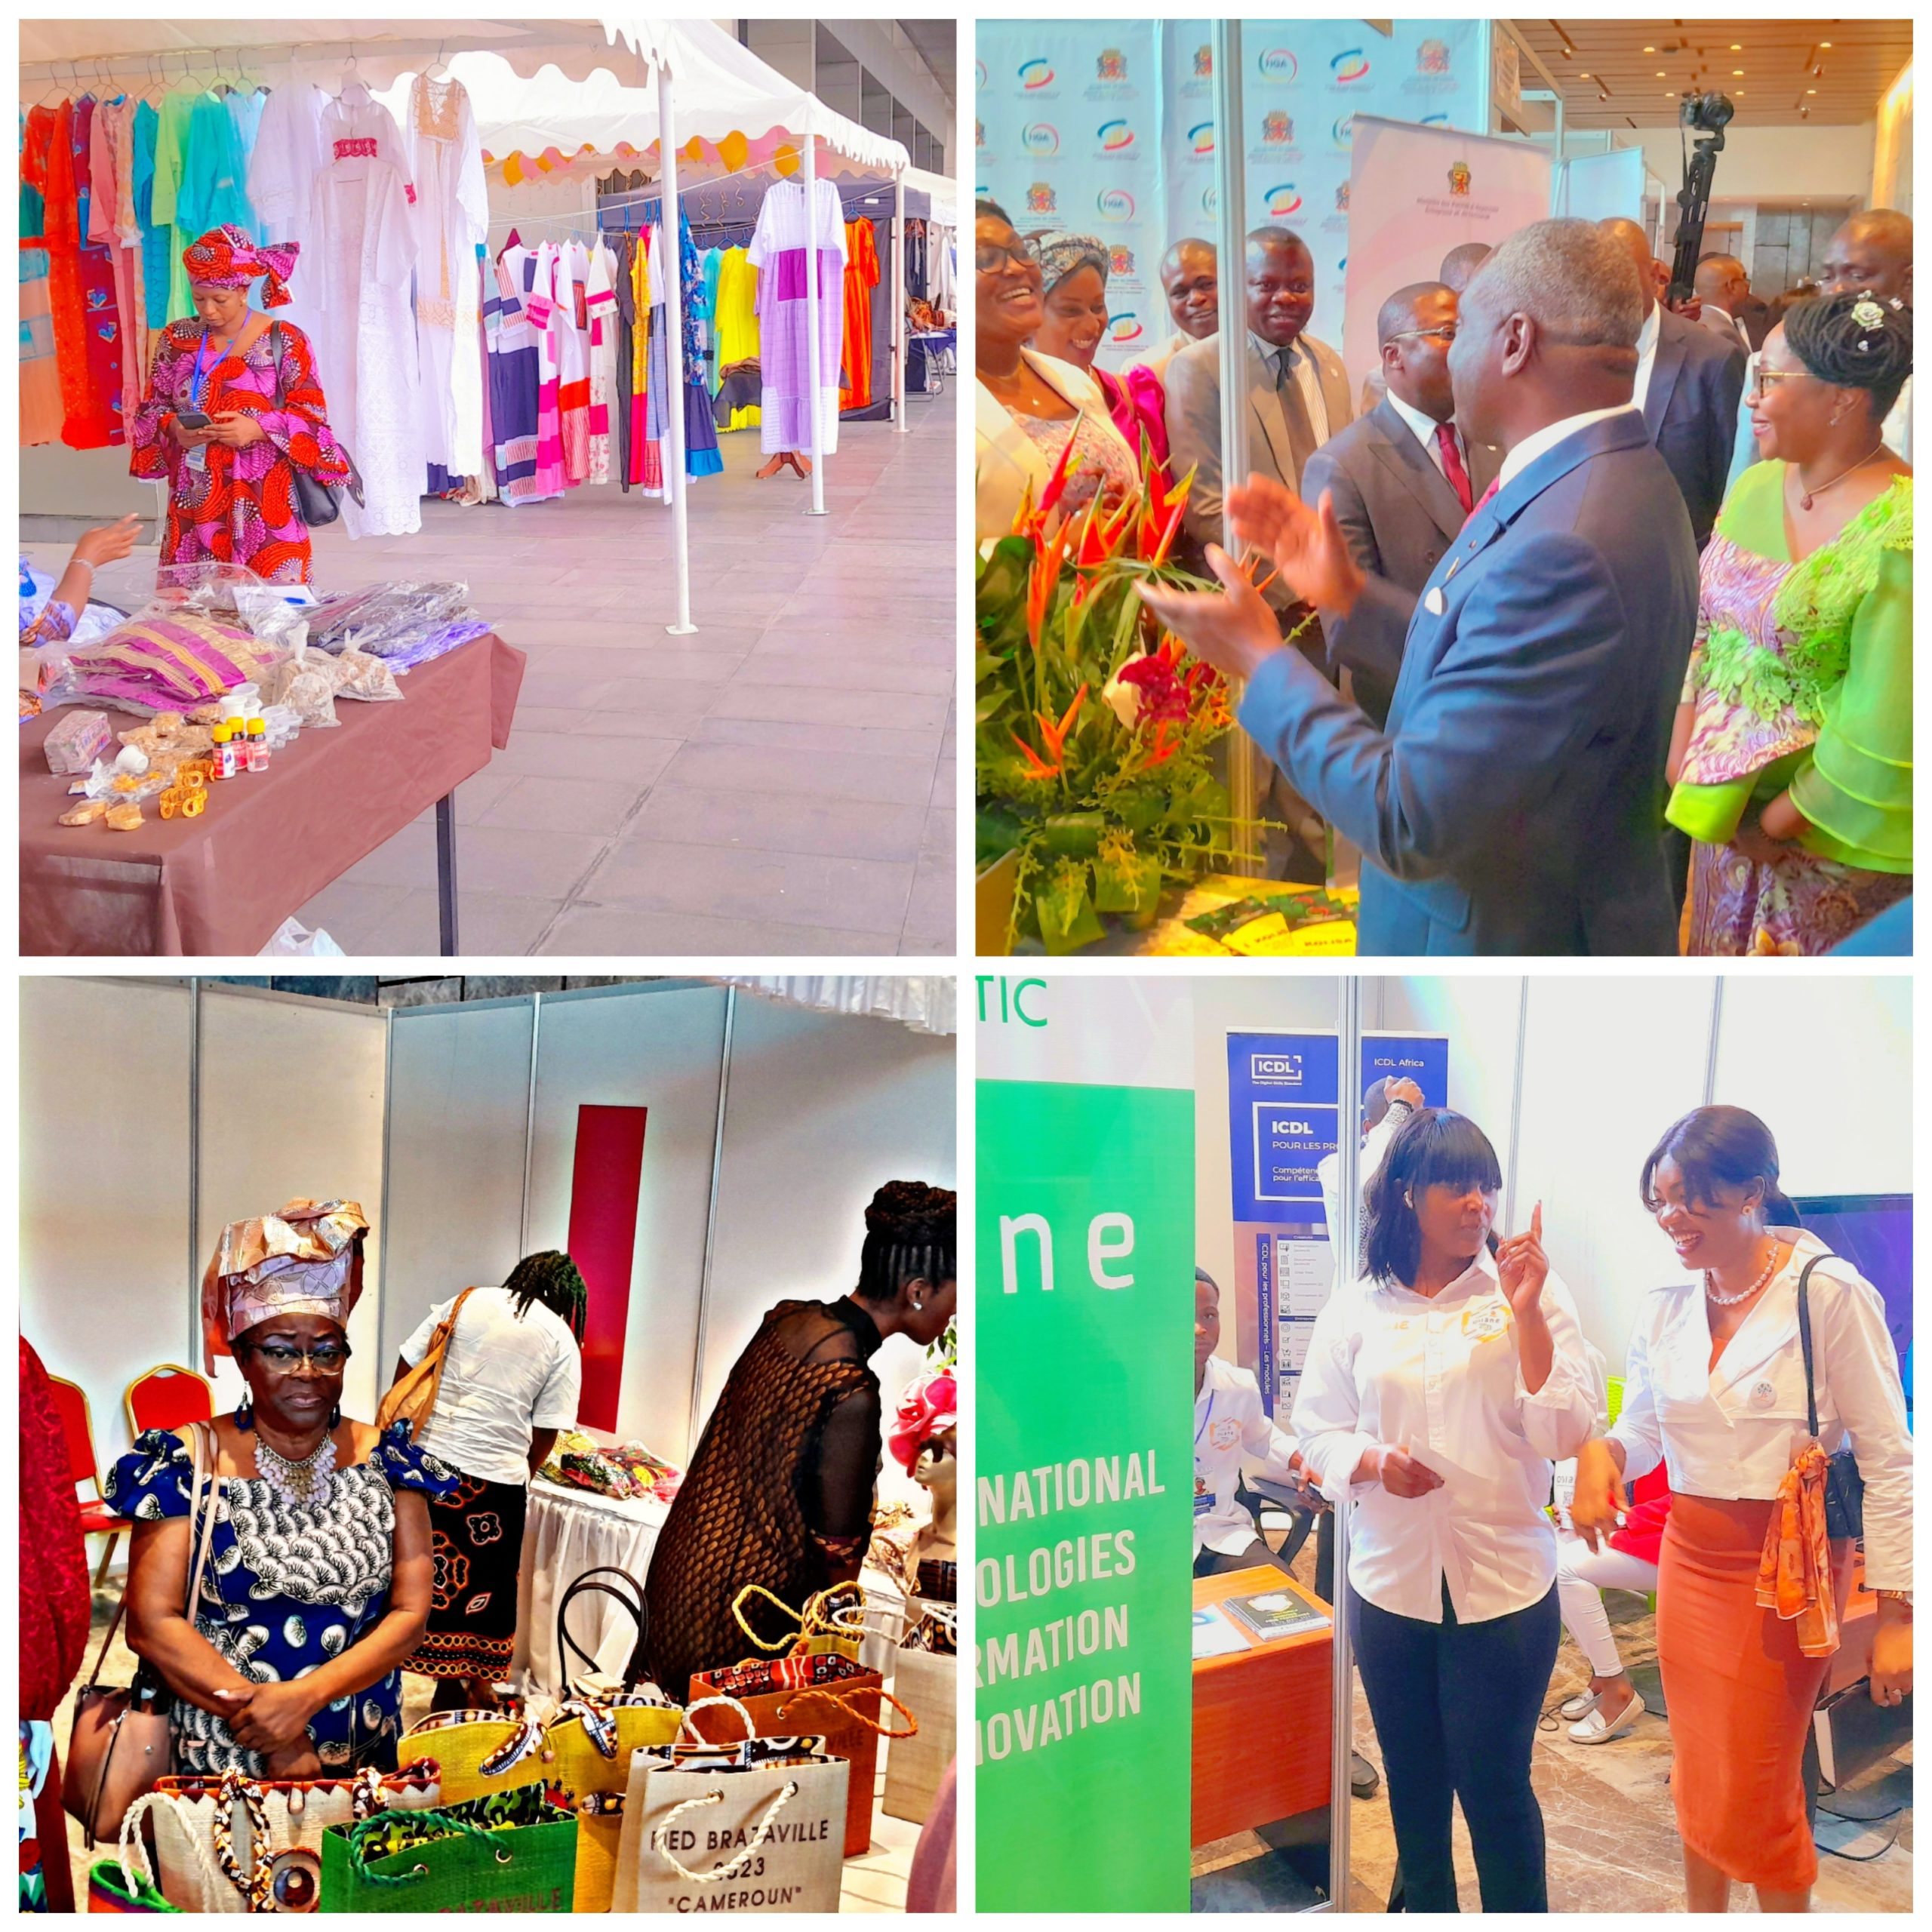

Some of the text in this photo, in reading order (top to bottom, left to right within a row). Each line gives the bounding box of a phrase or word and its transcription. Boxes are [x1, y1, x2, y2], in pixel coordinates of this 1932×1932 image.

[975, 976, 1048, 1027] TIC
[1258, 1060, 1294, 1073] ICDL
[1374, 1058, 1425, 1067] ICDL Africa
[1272, 1121, 1313, 1134] ICDL
[1272, 1141, 1301, 1149] POUR
[1303, 1142, 1321, 1150] LES
[1262, 1293, 1271, 1344] professionnels
[977, 1449, 1166, 1527] NATIONAL
[976, 1529, 1136, 1607] OLOGIES
[976, 1672, 1141, 1766] OVATION
